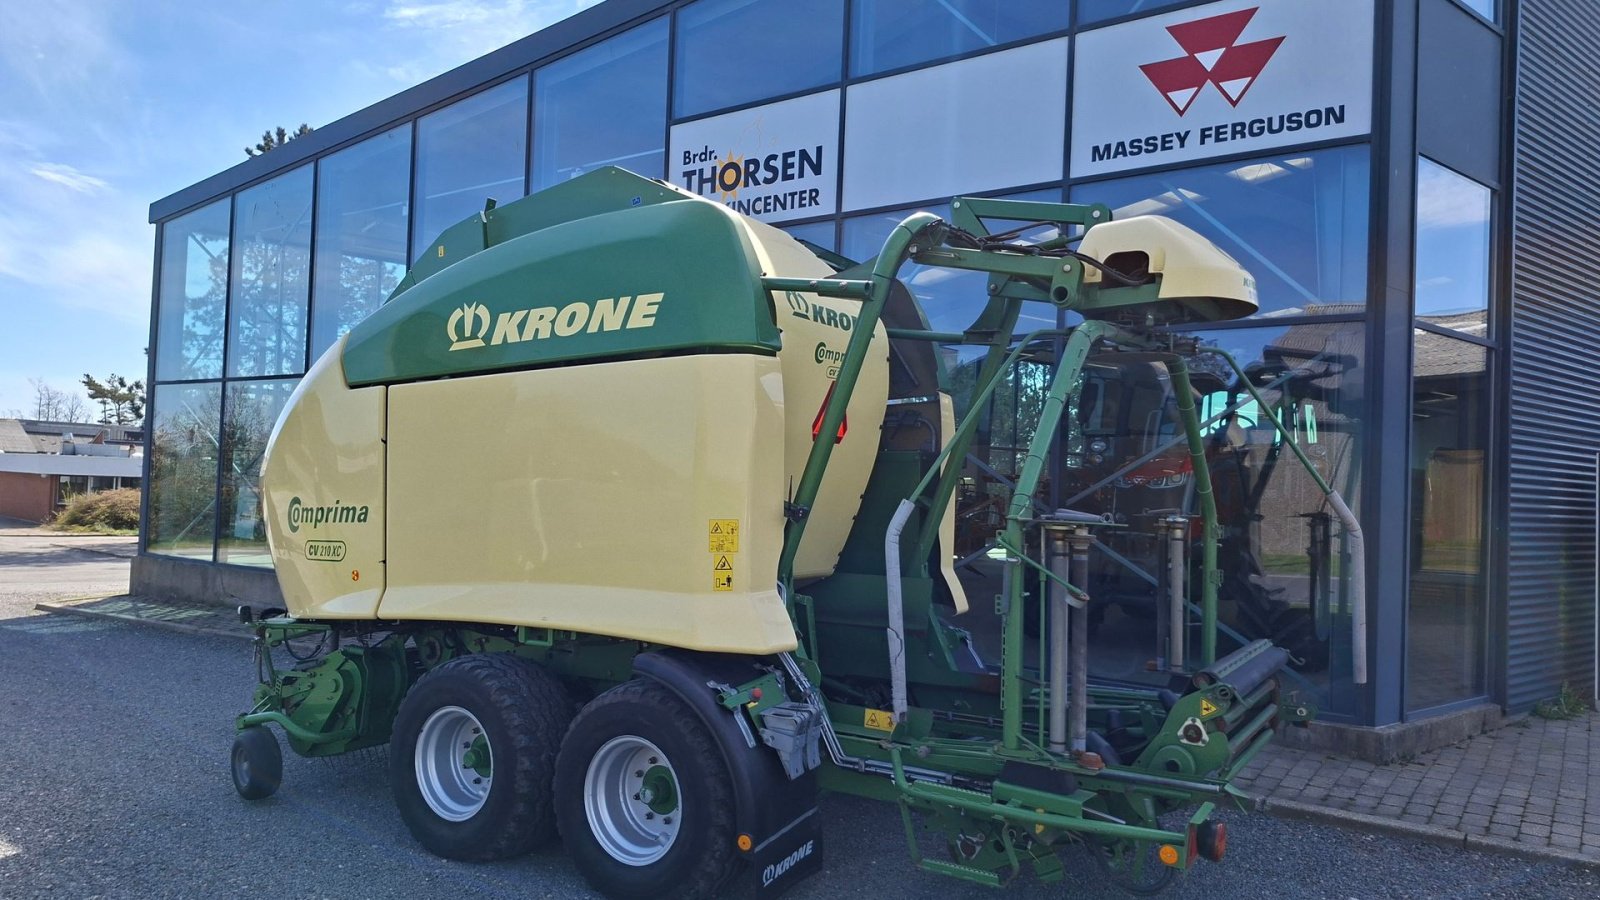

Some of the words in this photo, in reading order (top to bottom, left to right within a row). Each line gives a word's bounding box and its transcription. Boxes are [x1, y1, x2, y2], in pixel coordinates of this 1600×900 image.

[1091, 130, 1191, 162] MASSEY
[1200, 104, 1345, 145] FERGUSON
[682, 145, 823, 196] THORSEN
[683, 145, 718, 166] Brdr.
[490, 292, 665, 346] KRONE
[287, 496, 369, 534] Comprima
[309, 545, 319, 556] CV
[320, 545, 331, 556] 210
[774, 840, 813, 879] KRONE
